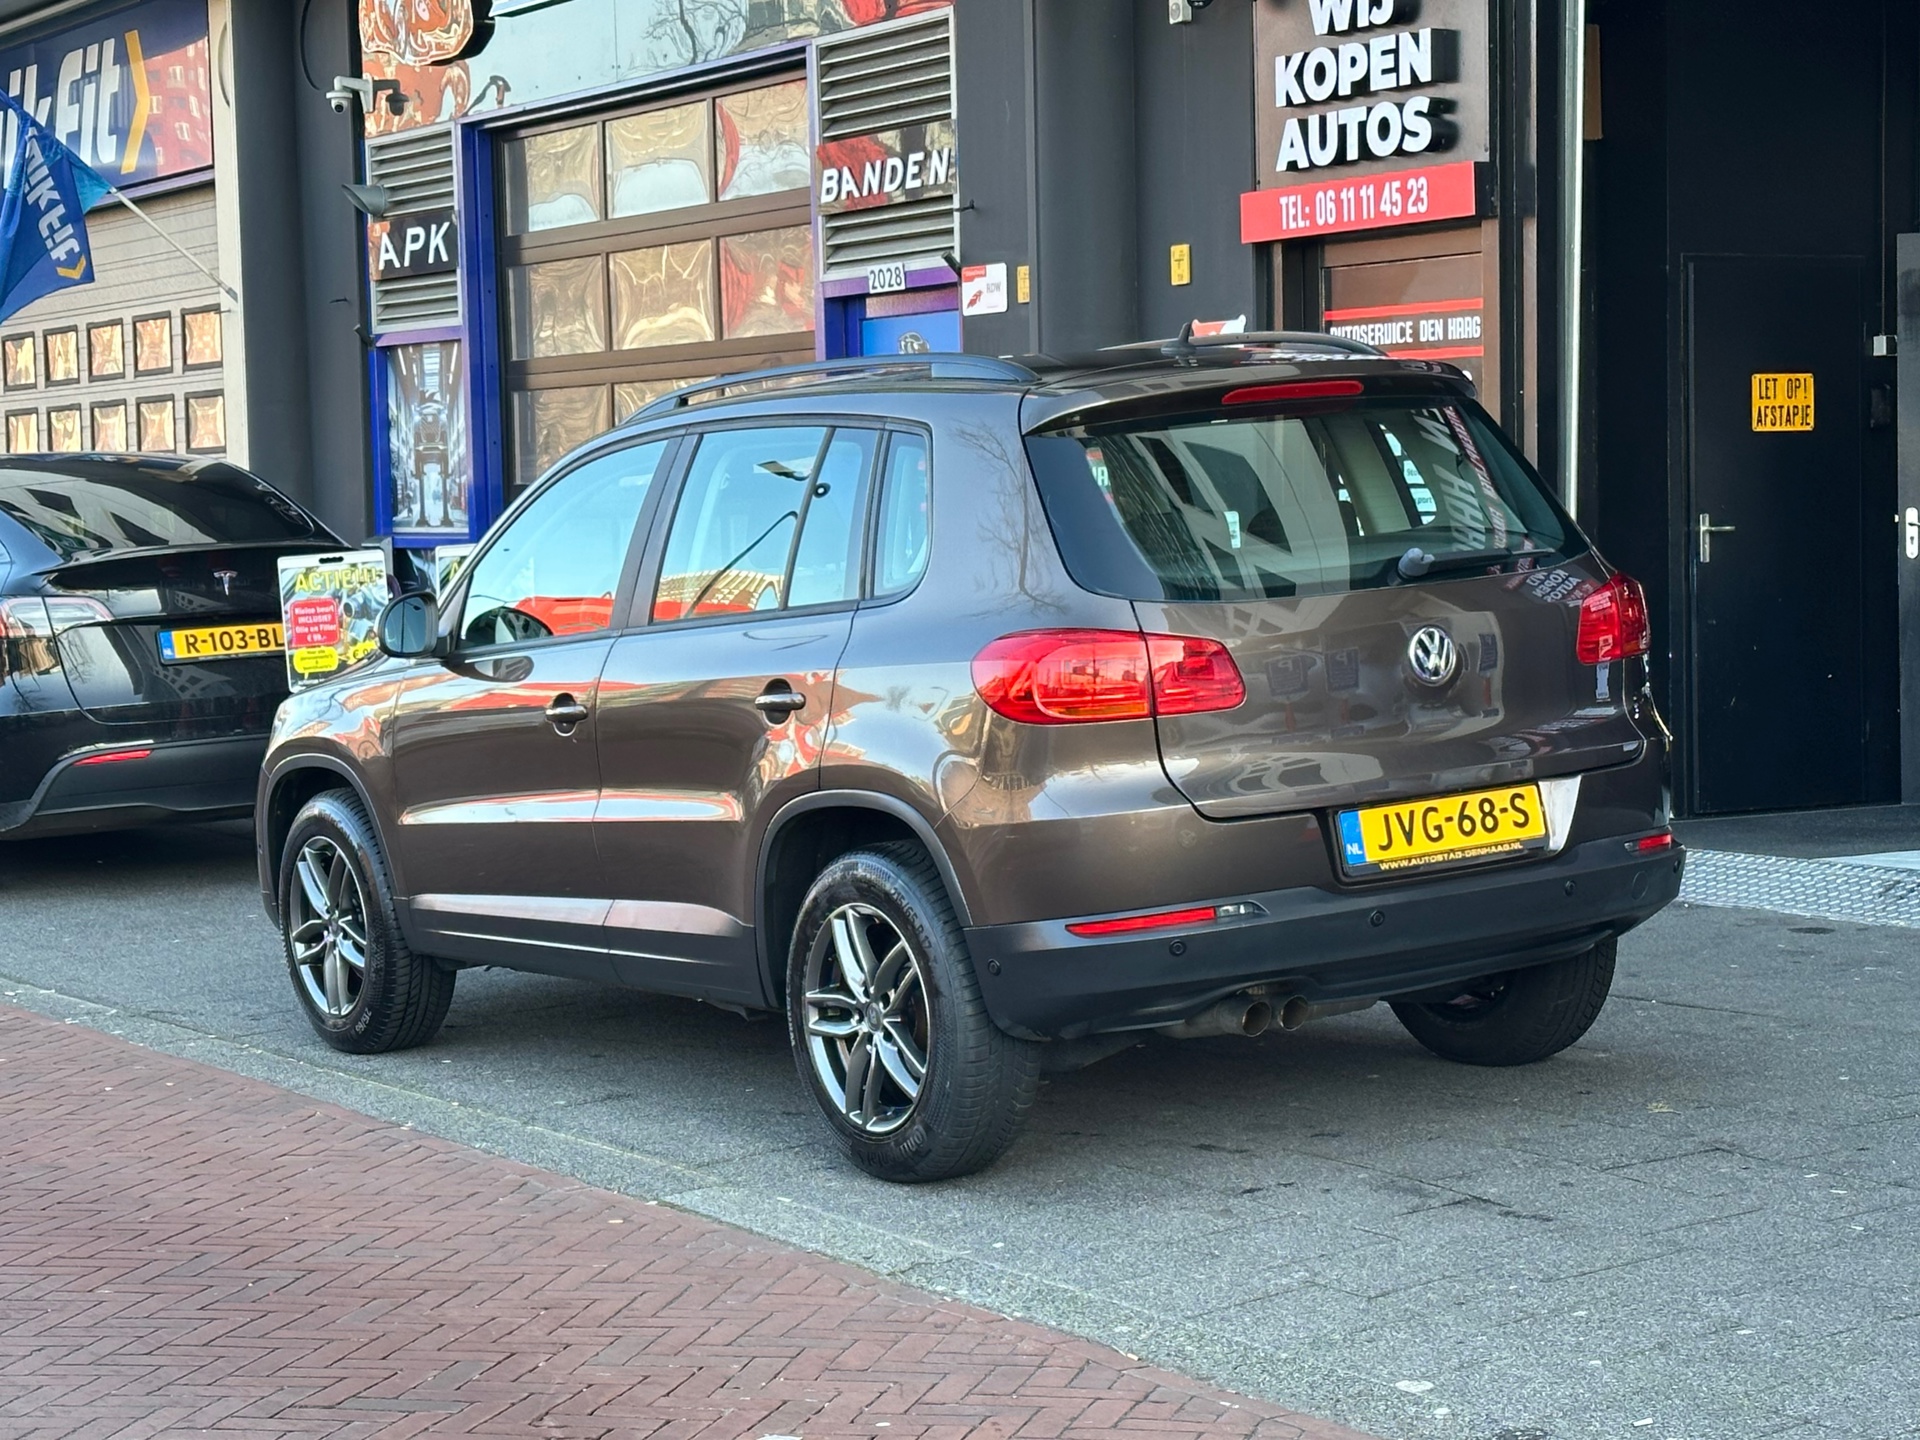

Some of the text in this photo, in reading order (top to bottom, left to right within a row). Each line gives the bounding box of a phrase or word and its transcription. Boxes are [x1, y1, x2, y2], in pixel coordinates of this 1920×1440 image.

[1308, 0, 1395, 36] WIJ
[1274, 27, 1432, 108] KOPEN
[1275, 95, 1432, 172] AUTOS
[820, 147, 952, 204] BANDEN
[1279, 176, 1429, 230] TEL: 06 11 11 45 23
[378, 222, 451, 271] APK
[869, 266, 902, 290] 2028
[1419, 318, 1444, 342] DEN
[1447, 315, 1481, 340] HAAG
[1758, 377, 1778, 400] LET
[1756, 404, 1811, 427] AFSTAPJE
[185, 627, 285, 654] R-103-BL
[1378, 793, 1530, 851] JVG-68-S
[1346, 843, 1363, 854] NL
